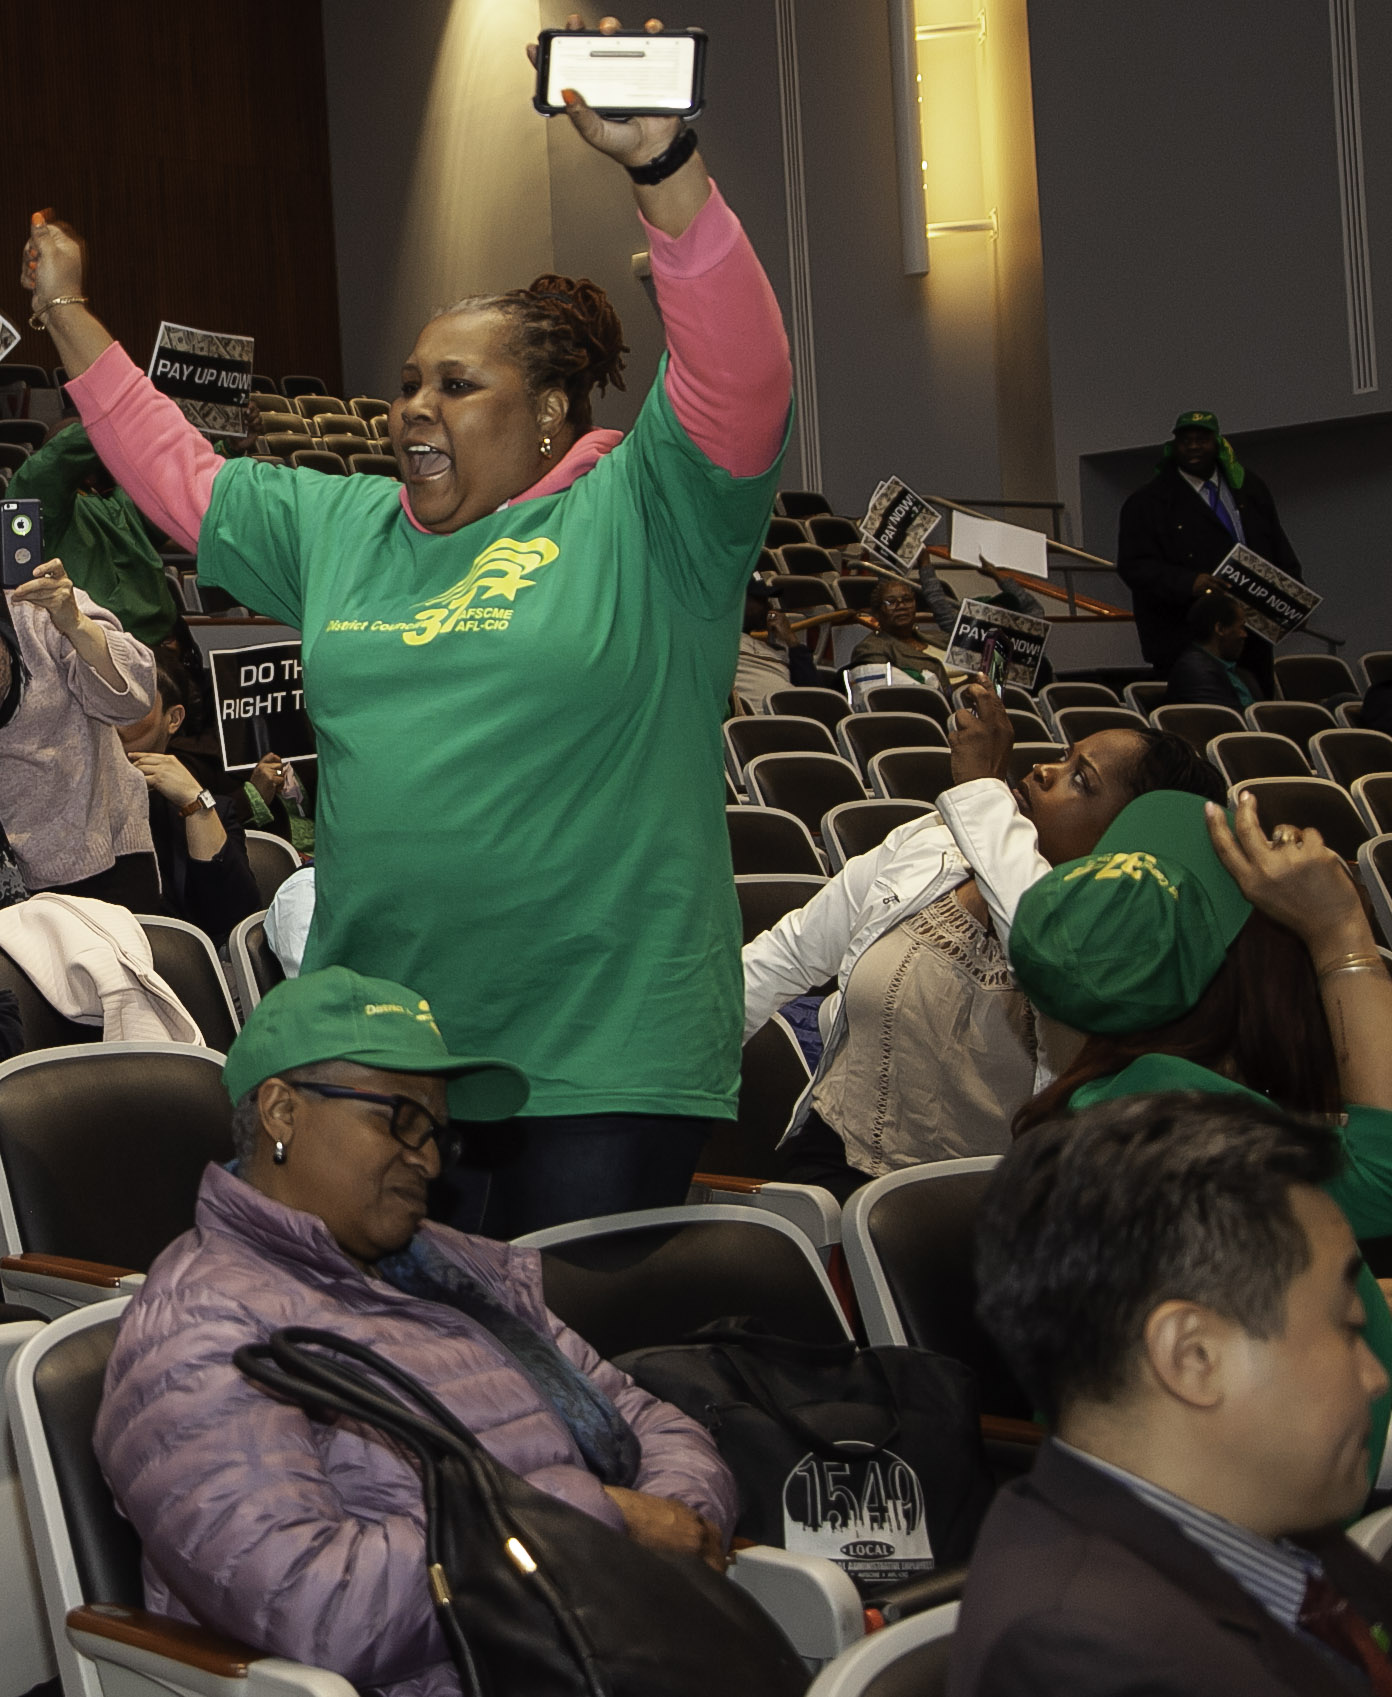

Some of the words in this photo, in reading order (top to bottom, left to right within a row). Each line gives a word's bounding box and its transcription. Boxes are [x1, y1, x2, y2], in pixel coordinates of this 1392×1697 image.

[156, 359, 194, 381] PAY
[195, 367, 217, 385] UP
[1221, 564, 1250, 586] PAY
[1248, 582, 1269, 598] UP
[455, 620, 509, 632] AFL-CIO
[457, 607, 514, 620] AFSCME
[958, 623, 988, 641] PAY
[240, 662, 275, 687] DO
[222, 691, 287, 720] RIGHT
[795, 1460, 921, 1534] 1549
[849, 1544, 889, 1556] LOCAL
